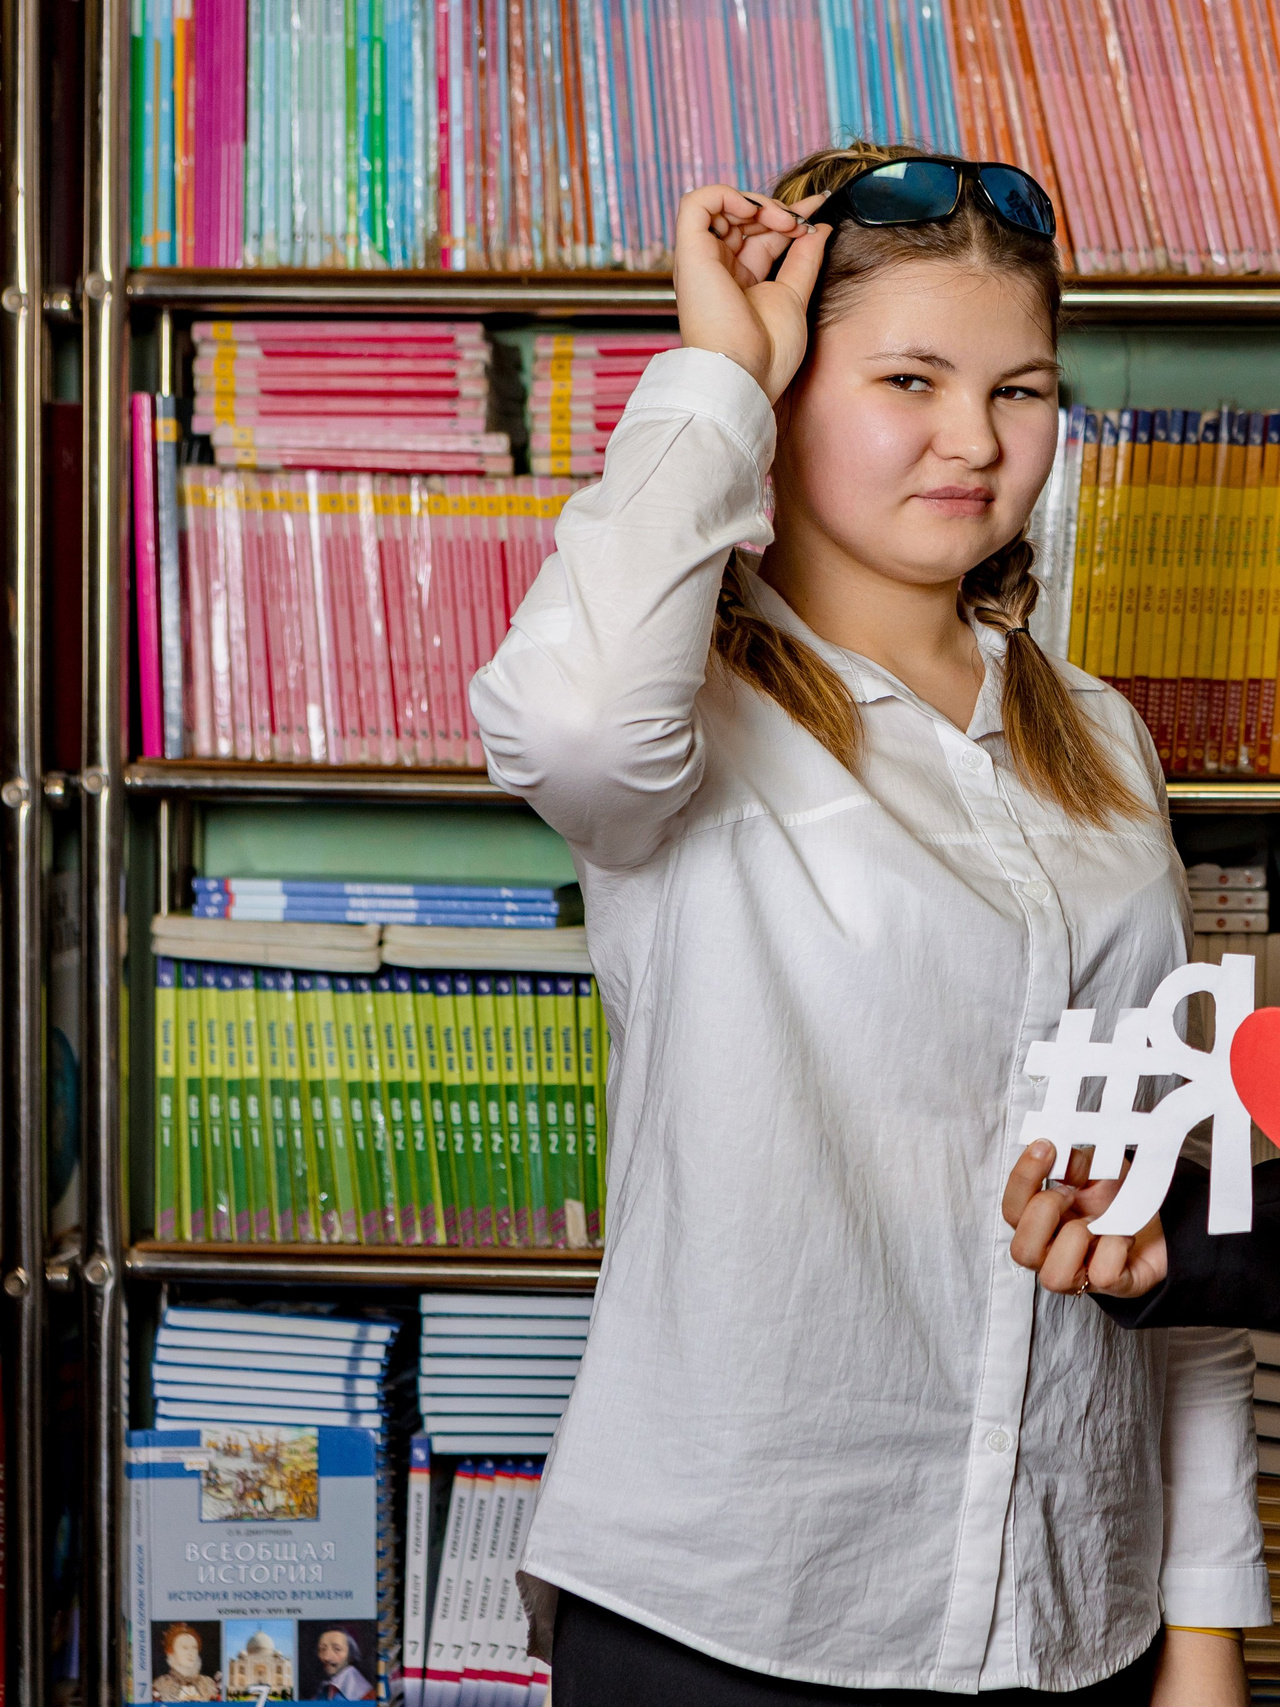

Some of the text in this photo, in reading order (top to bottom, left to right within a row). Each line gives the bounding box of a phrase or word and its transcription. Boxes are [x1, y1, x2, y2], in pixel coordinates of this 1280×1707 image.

[161, 1094, 171, 1118] 6
[189, 1095, 199, 1118] 6
[209, 1094, 220, 1118] 6
[229, 1096, 240, 1120] 6
[247, 1094, 258, 1118] 6
[273, 1096, 283, 1120] 6
[290, 1097, 301, 1120] 6
[312, 1097, 323, 1120] 6
[331, 1096, 342, 1120] 6
[351, 1098, 362, 1122] 6
[390, 1098, 402, 1122] 6
[410, 1099, 422, 1122] 6
[432, 1099, 444, 1122] 6
[450, 1102, 462, 1124] 6
[468, 1101, 480, 1124] 6
[488, 1101, 499, 1125] 6
[507, 1101, 518, 1125] 6
[527, 1101, 539, 1125] 6
[547, 1101, 558, 1125] 6
[565, 1102, 575, 1126] 6
[585, 1103, 596, 1126] 6
[163, 1126, 170, 1147] 1
[191, 1126, 198, 1147] 1
[213, 1126, 220, 1147] 1
[233, 1128, 240, 1149] 1
[252, 1126, 259, 1147] 1
[277, 1128, 284, 1148] 1
[294, 1127, 301, 1149] 1
[317, 1128, 325, 1149] 1
[336, 1126, 344, 1148] 1
[356, 1130, 364, 1150] 1
[394, 1129, 405, 1150] 2
[414, 1129, 425, 1151] 2
[436, 1129, 446, 1151] 2
[454, 1132, 464, 1154] 2
[472, 1131, 482, 1153] 2
[491, 1132, 502, 1153] 2
[510, 1132, 520, 1153] 2
[529, 1132, 540, 1153] 2
[549, 1132, 559, 1154] 2
[566, 1133, 576, 1154] 2
[587, 1134, 596, 1155] 2
[185, 1540, 336, 1563] ВСЕОБЩАЯ
[197, 1563, 323, 1585] ИСТОРИЯ
[167, 1590, 354, 1602] ИСТОРИЯ НОВОГО ВРЕМЕНИ
[407, 1640, 419, 1656] 7
[433, 1642, 444, 1657] 7
[452, 1644, 463, 1659] 7
[470, 1641, 482, 1657] 7
[488, 1643, 500, 1658] 7
[507, 1644, 518, 1660] 7
